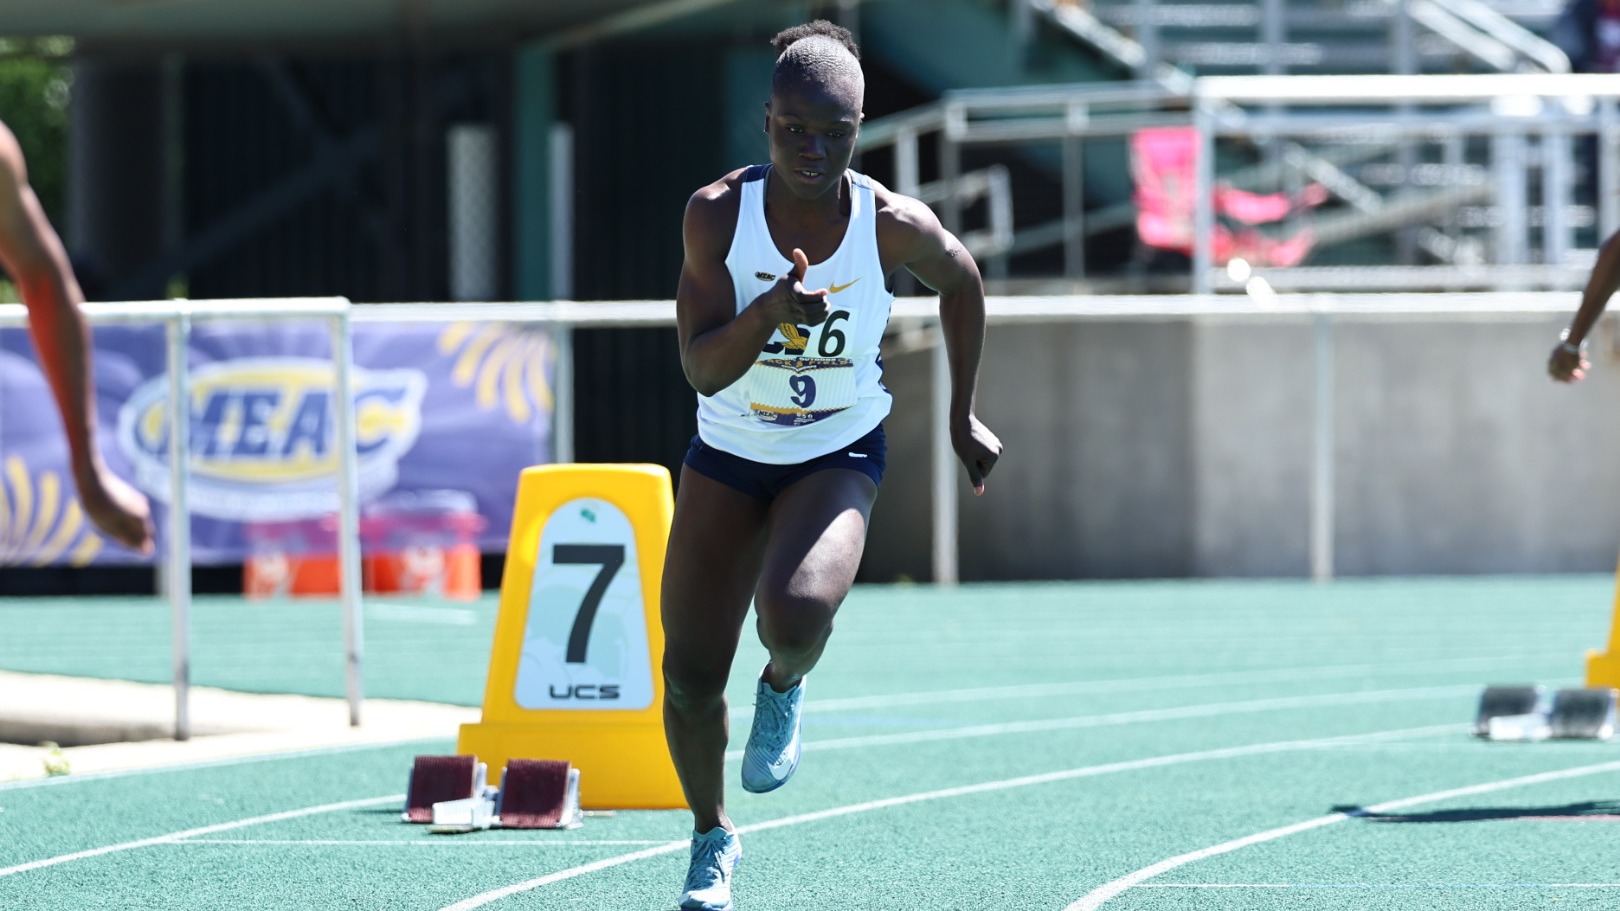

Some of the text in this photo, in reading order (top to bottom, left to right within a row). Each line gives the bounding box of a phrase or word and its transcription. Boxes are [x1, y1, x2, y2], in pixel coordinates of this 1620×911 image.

[818, 310, 850, 357] 6
[789, 374, 816, 408] 9
[156, 387, 408, 457] MEAC
[553, 544, 625, 663] 7
[549, 684, 620, 699] UCS
